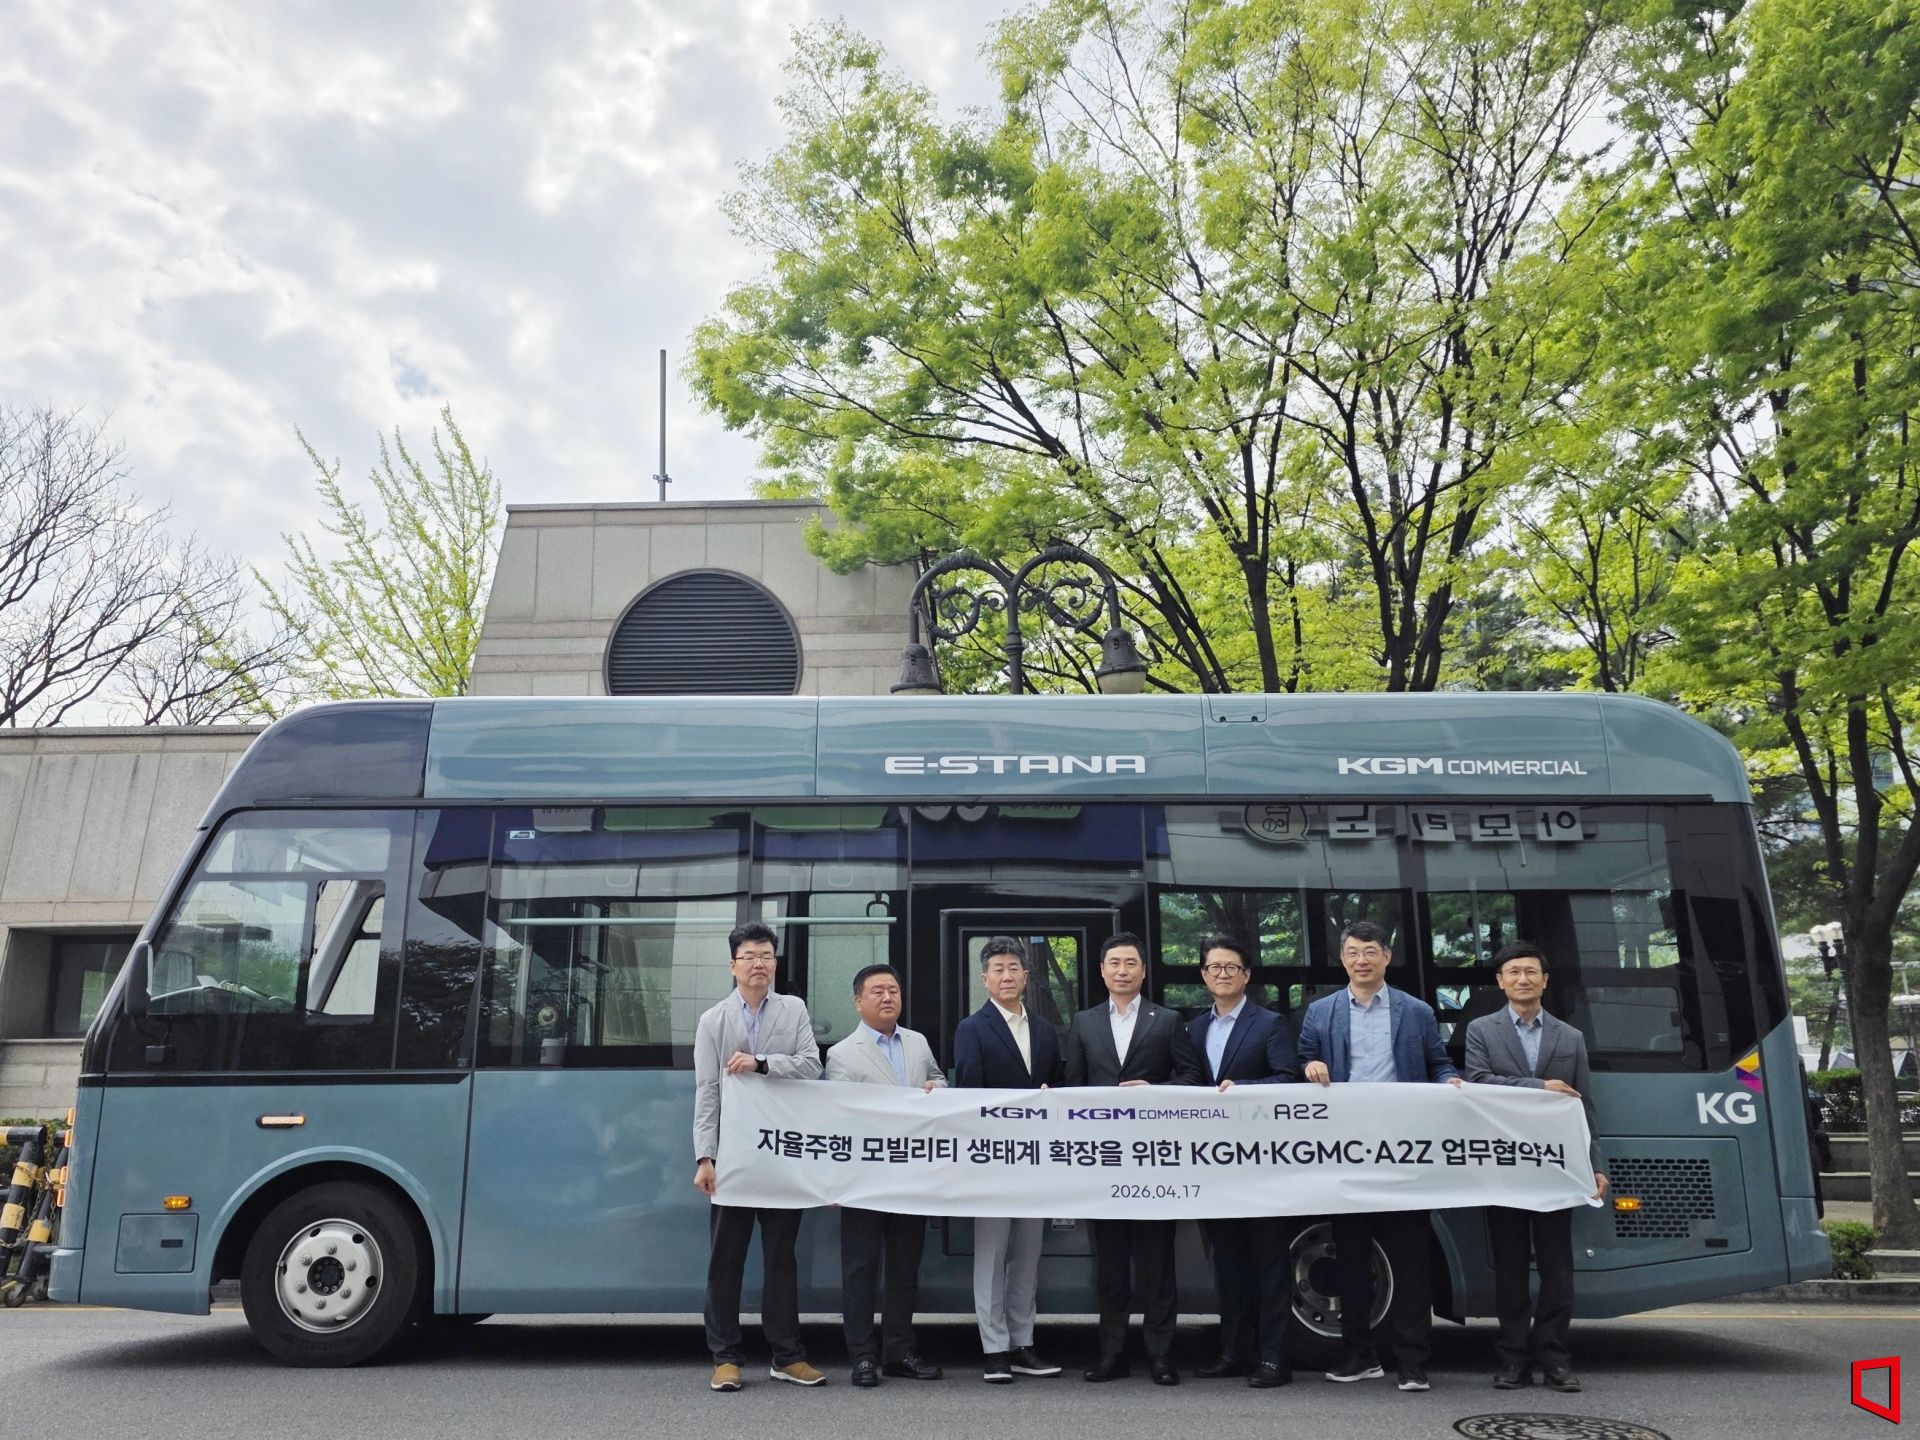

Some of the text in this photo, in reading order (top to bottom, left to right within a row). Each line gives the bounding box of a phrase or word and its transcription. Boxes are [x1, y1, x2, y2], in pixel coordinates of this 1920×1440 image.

[884, 755, 1146, 775] E-STANA
[1337, 757, 1588, 775] KGM COMMERCIAL
[980, 1103, 1329, 1119] KGM KGM COMMERCIAL A2Z
[1696, 1091, 1757, 1125] KG
[756, 1129, 853, 1162] 자율주행
[860, 1136, 958, 1164] 모빌리티
[966, 1138, 1040, 1165] 생태계
[1048, 1139, 1123, 1166] 확장을
[1132, 1139, 1183, 1166] 위한
[1441, 1138, 1566, 1169] 업무협약식
[1111, 1184, 1201, 1198] 2026.04.17
